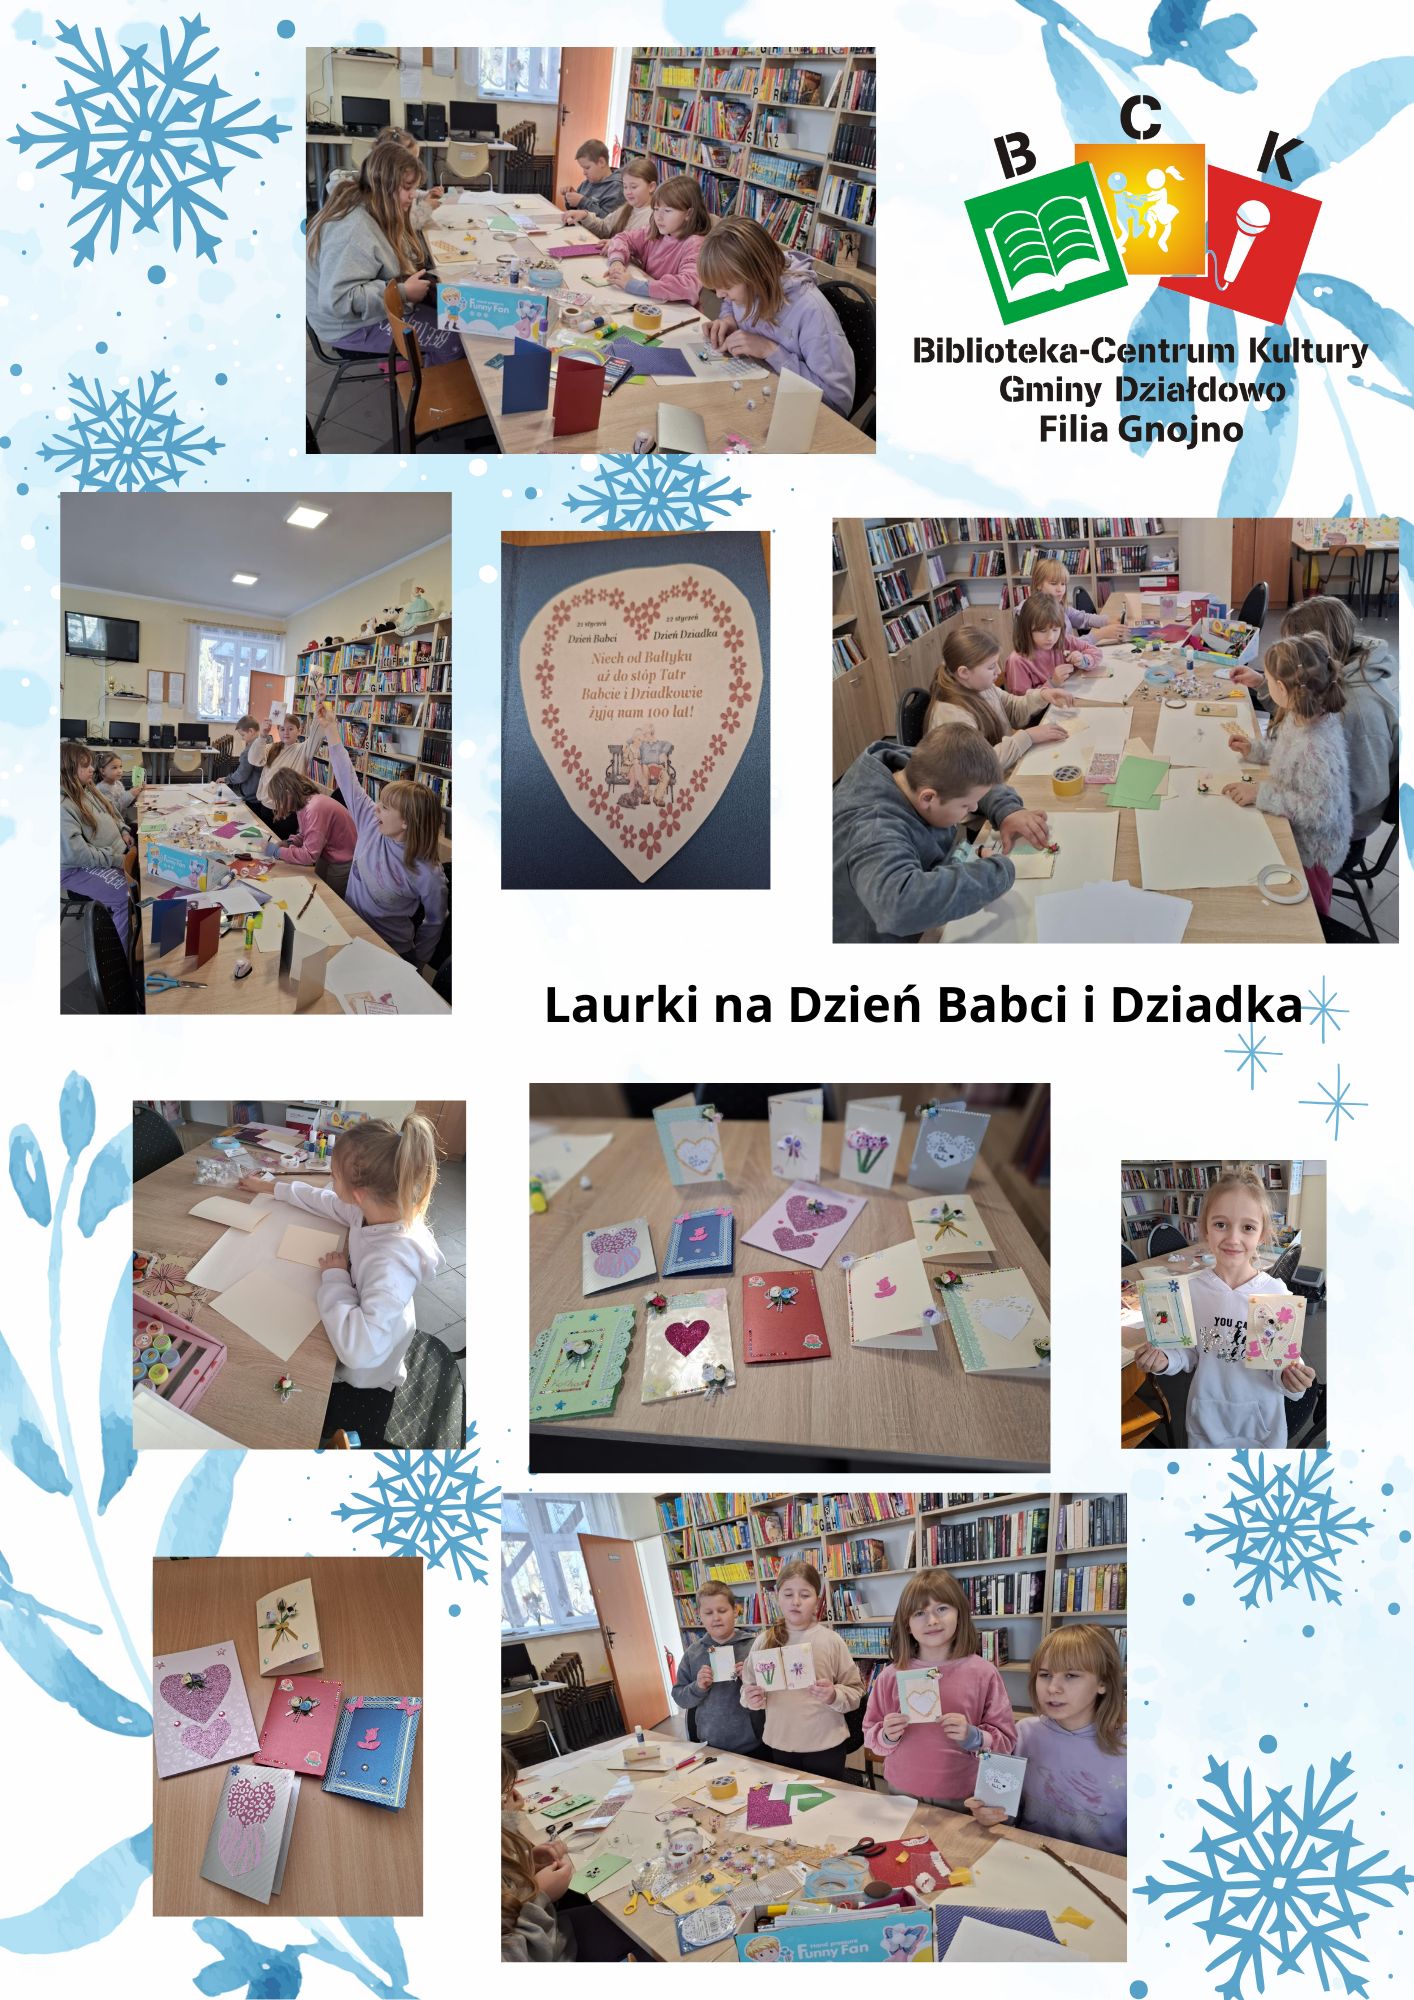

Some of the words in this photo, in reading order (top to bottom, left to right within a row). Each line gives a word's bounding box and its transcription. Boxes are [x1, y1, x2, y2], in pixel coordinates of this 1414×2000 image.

[469, 298, 493, 313] Funny
[493, 305, 510, 314] Fan
[568, 634, 592, 644] Dzień
[593, 633, 618, 643] Babci
[653, 630, 678, 641] Dzień
[680, 628, 718, 640] Dziadka
[591, 651, 624, 664] Niech
[627, 651, 642, 663] od
[644, 649, 692, 665] Bałtyku
[597, 669, 611, 682] aż
[613, 669, 628, 682] do
[631, 668, 656, 684] stóp
[660, 668, 686, 680] Tatr
[582, 687, 620, 700] Babcie
[624, 688, 629, 699] i
[631, 685, 703, 700] Dziadkowie
[589, 705, 614, 721] żyją
[617, 708, 644, 718] nam
[648, 707, 669, 718] 100
[672, 704, 694, 718] lat!
[1214, 1316, 1232, 1327] YOU
[797, 1943, 839, 1959] Funny
[841, 1943, 869, 1955] Fan
